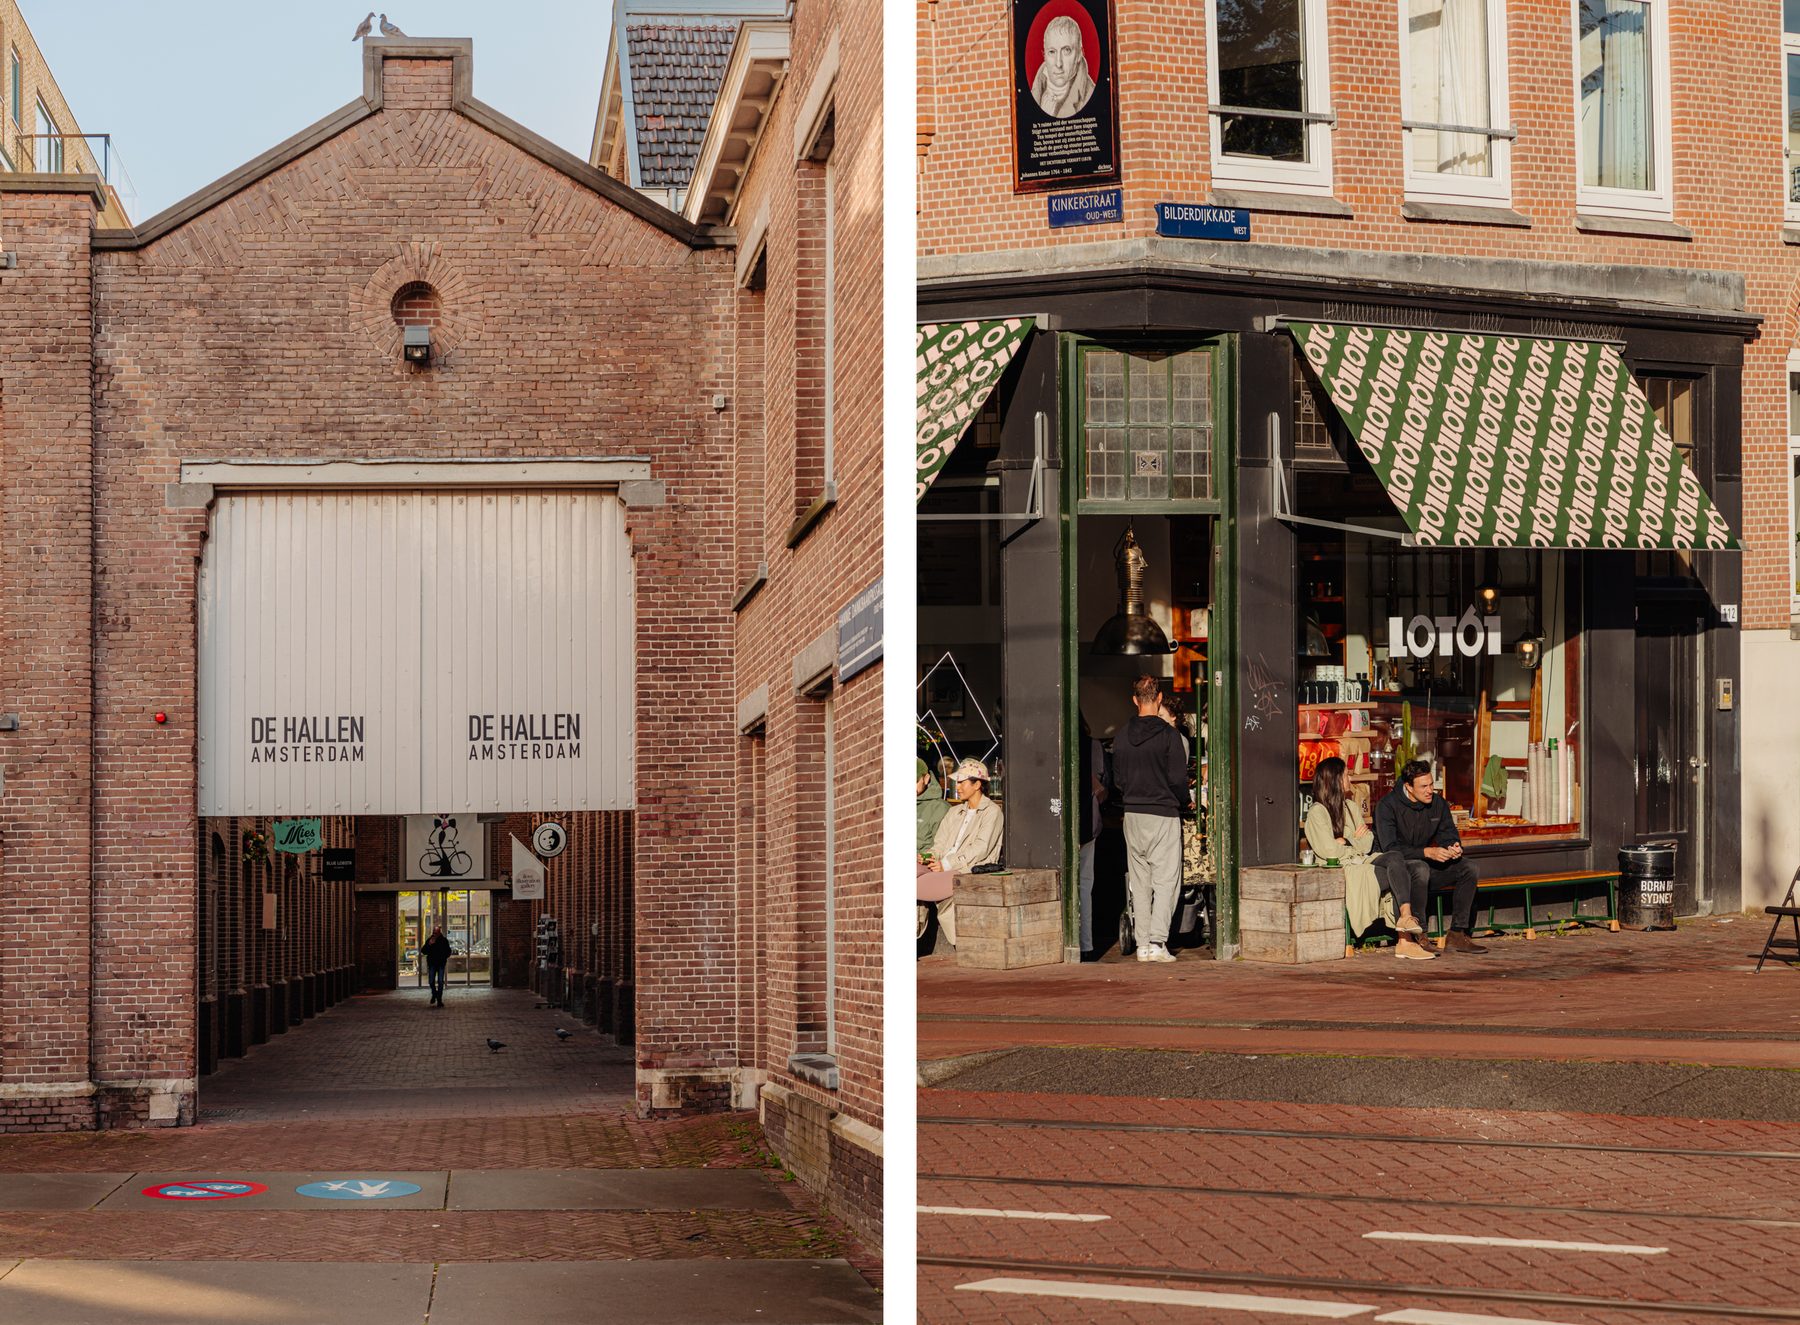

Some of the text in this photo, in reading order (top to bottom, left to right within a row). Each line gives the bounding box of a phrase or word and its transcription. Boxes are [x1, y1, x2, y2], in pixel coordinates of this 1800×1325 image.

[1052, 193, 1117, 211] KINKERSTRAAT
[1086, 209, 1117, 220] OUD-WEST
[1164, 206, 1236, 225] BILDERDIJKKADE
[1233, 226, 1247, 235] WEST
[1723, 607, 1735, 619] 112
[1388, 604, 1501, 658] LOT61
[251, 716, 364, 743] DE HALLEN
[468, 713, 580, 741] DE HALLEN
[251, 745, 364, 763] AMSTERDAM
[468, 742, 581, 761] AMSTERDAM
[280, 825, 315, 845] Mies
[1641, 880, 1673, 892] BORN IN
[1641, 892, 1672, 904] SYDNEY
